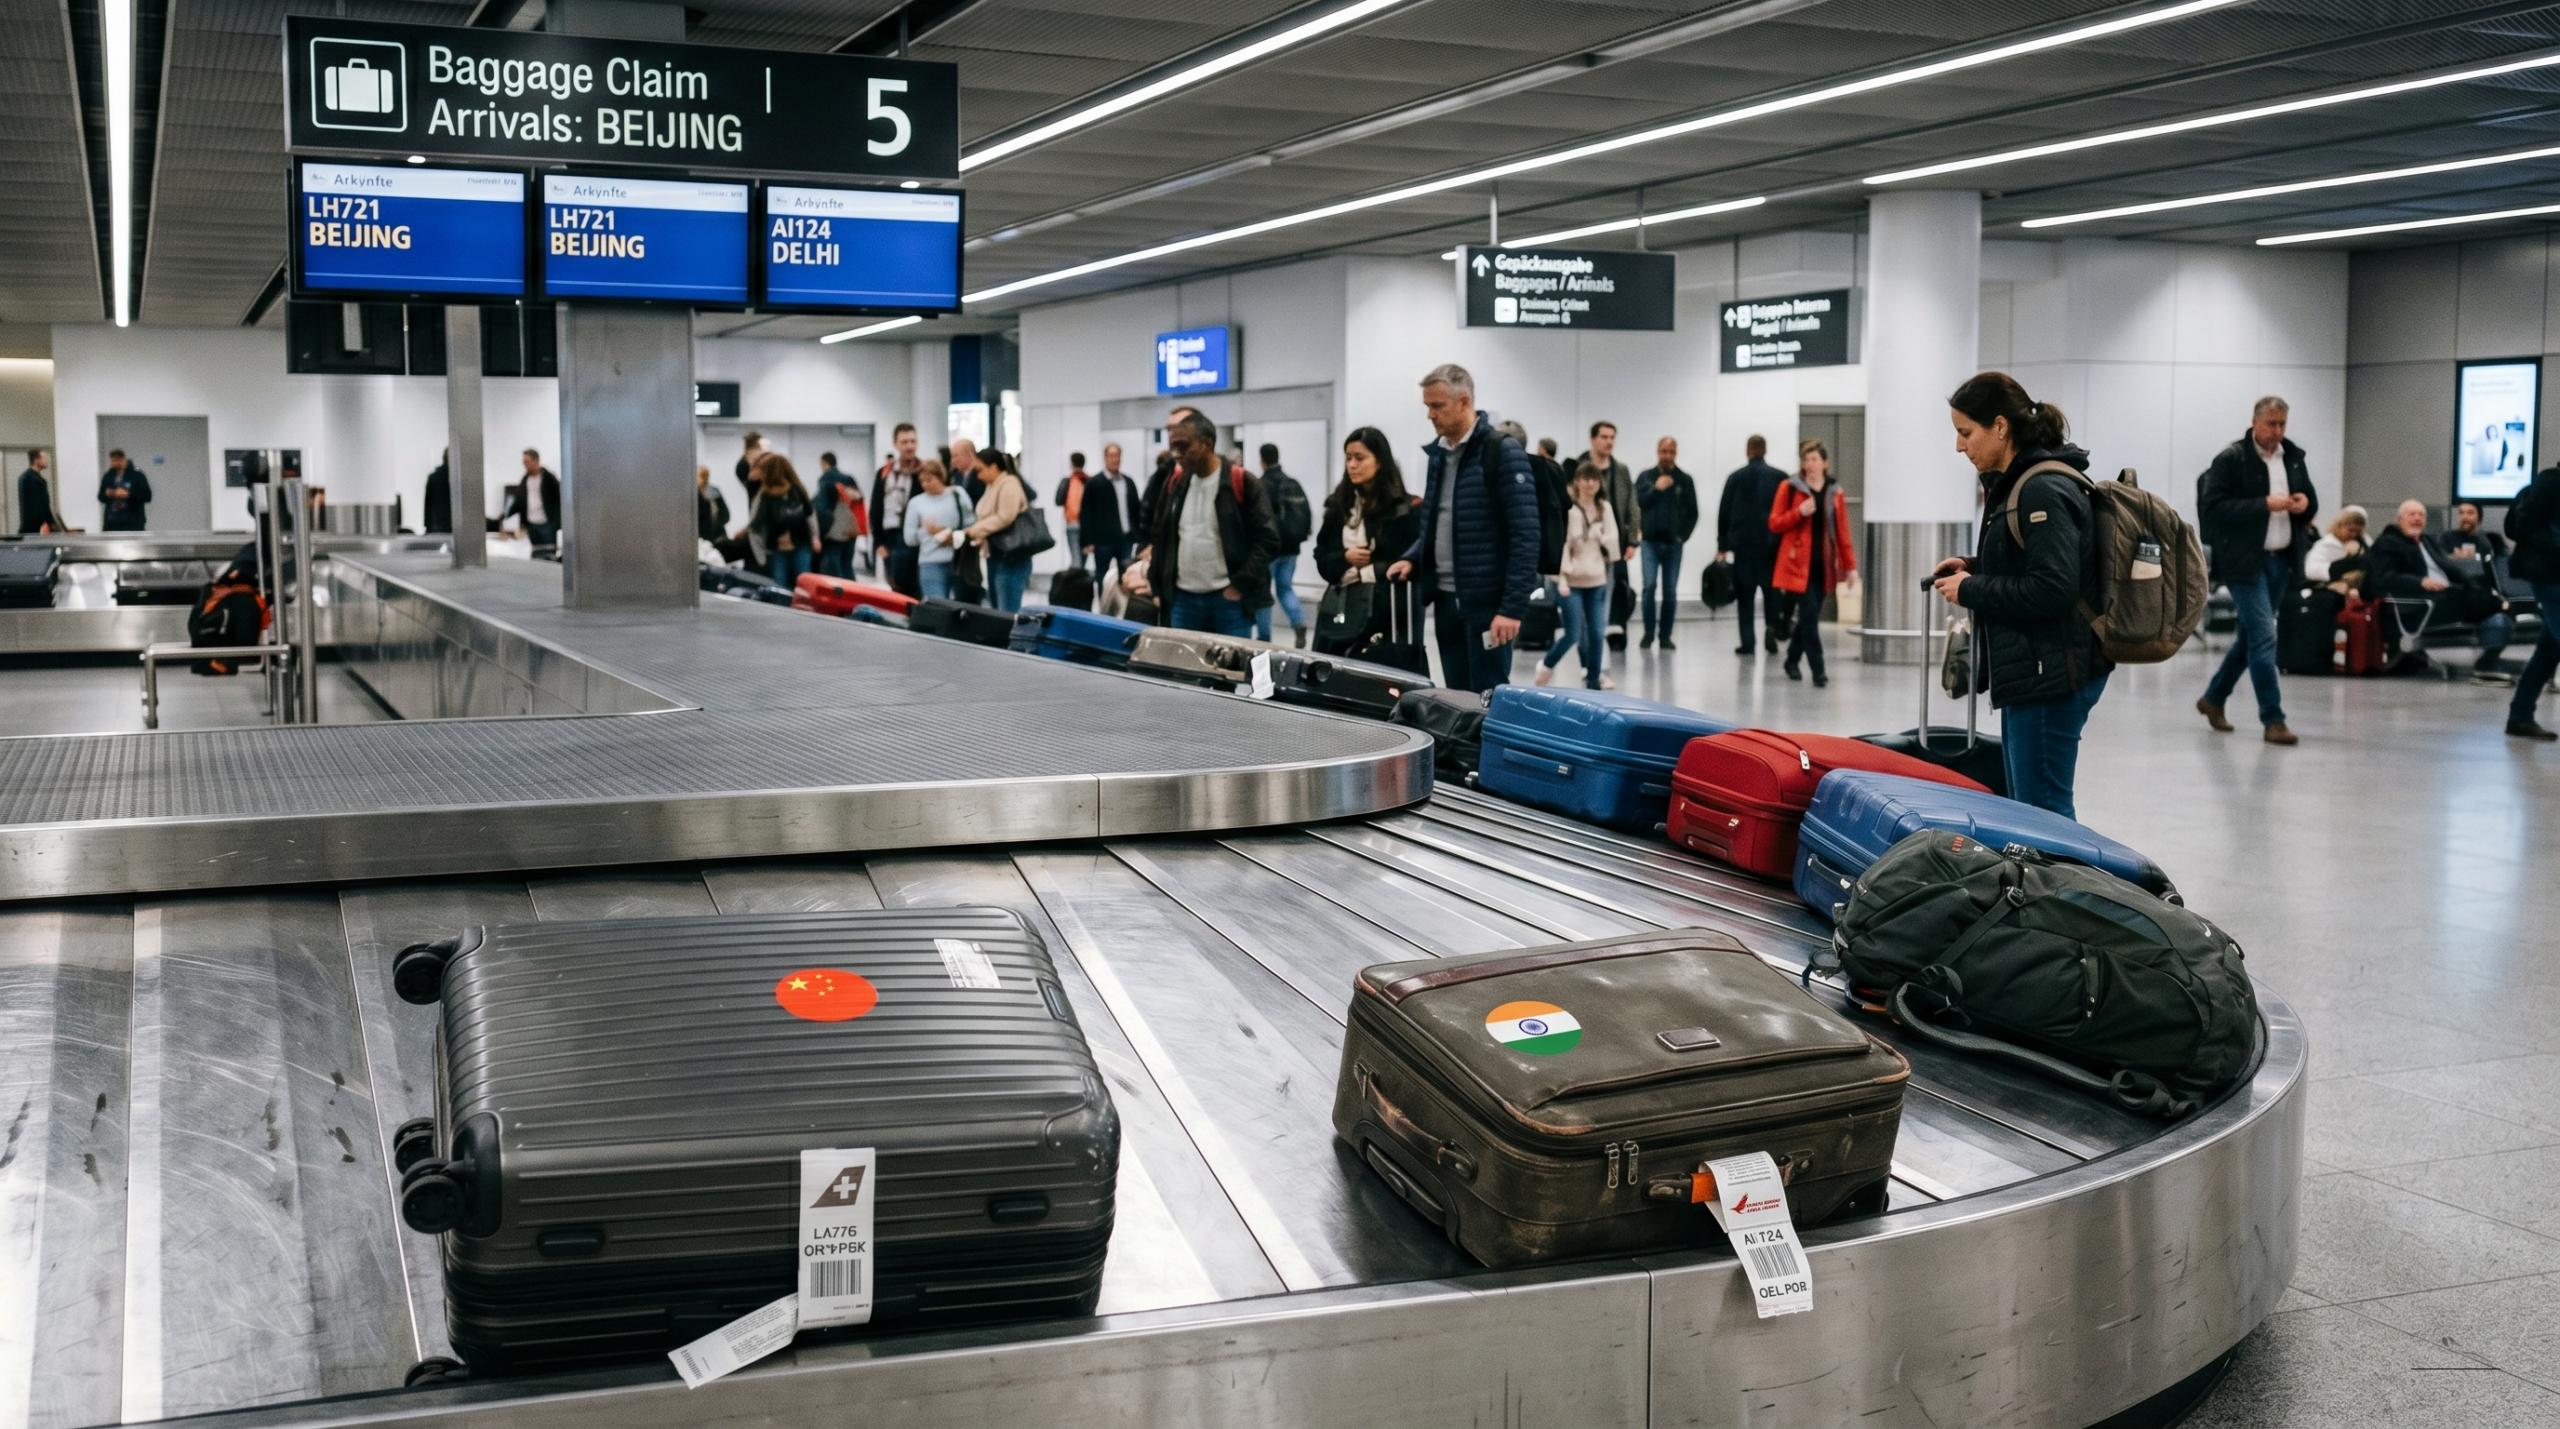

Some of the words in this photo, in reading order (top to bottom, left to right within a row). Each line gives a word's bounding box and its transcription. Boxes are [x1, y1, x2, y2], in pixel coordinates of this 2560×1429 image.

[429, 45, 593, 99] Baggage
[606, 57, 708, 100] Claim
[428, 98, 583, 143] Arrivals:
[597, 107, 743, 152] BEIJING
[866, 77, 912, 157] 5
[308, 196, 380, 221] LH721
[550, 207, 615, 231] LH721
[309, 221, 412, 250] BEIJING
[771, 217, 832, 240] AI124
[550, 231, 645, 259] BEIJING
[772, 241, 840, 266] DELHI
